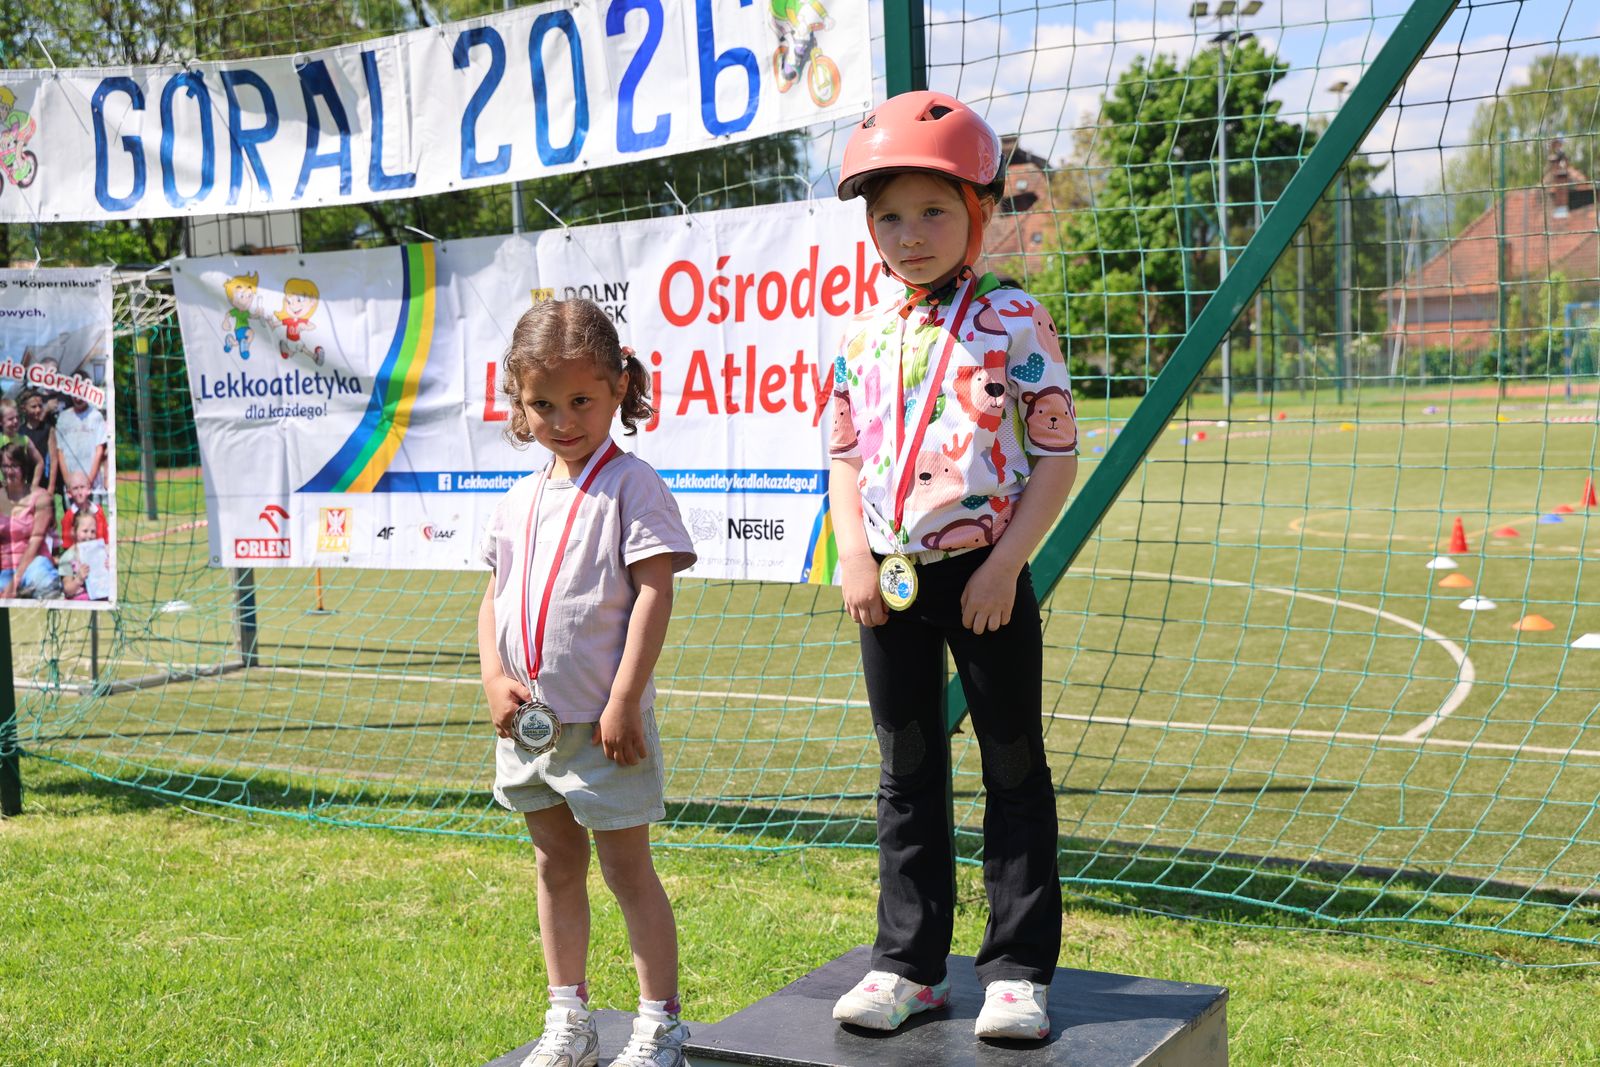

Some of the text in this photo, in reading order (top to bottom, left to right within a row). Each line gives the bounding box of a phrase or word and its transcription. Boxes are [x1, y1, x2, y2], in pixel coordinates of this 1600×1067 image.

[91, 0, 761, 212] GÓRAL 2026
[564, 282, 629, 302] DOLNY
[659, 241, 881, 327] Ośrodek
[30, 366, 104, 405] Górskim
[201, 369, 362, 399] Lekkoatletyka
[676, 345, 835, 427] Atlety
[245, 402, 328, 420] dla każdego!
[457, 474, 522, 490] Lekkoatlety
[662, 473, 818, 493] w.lekkoatletykadlakazdego.pl
[728, 518, 784, 541] Nestlé
[236, 541, 290, 557] ORLEN
